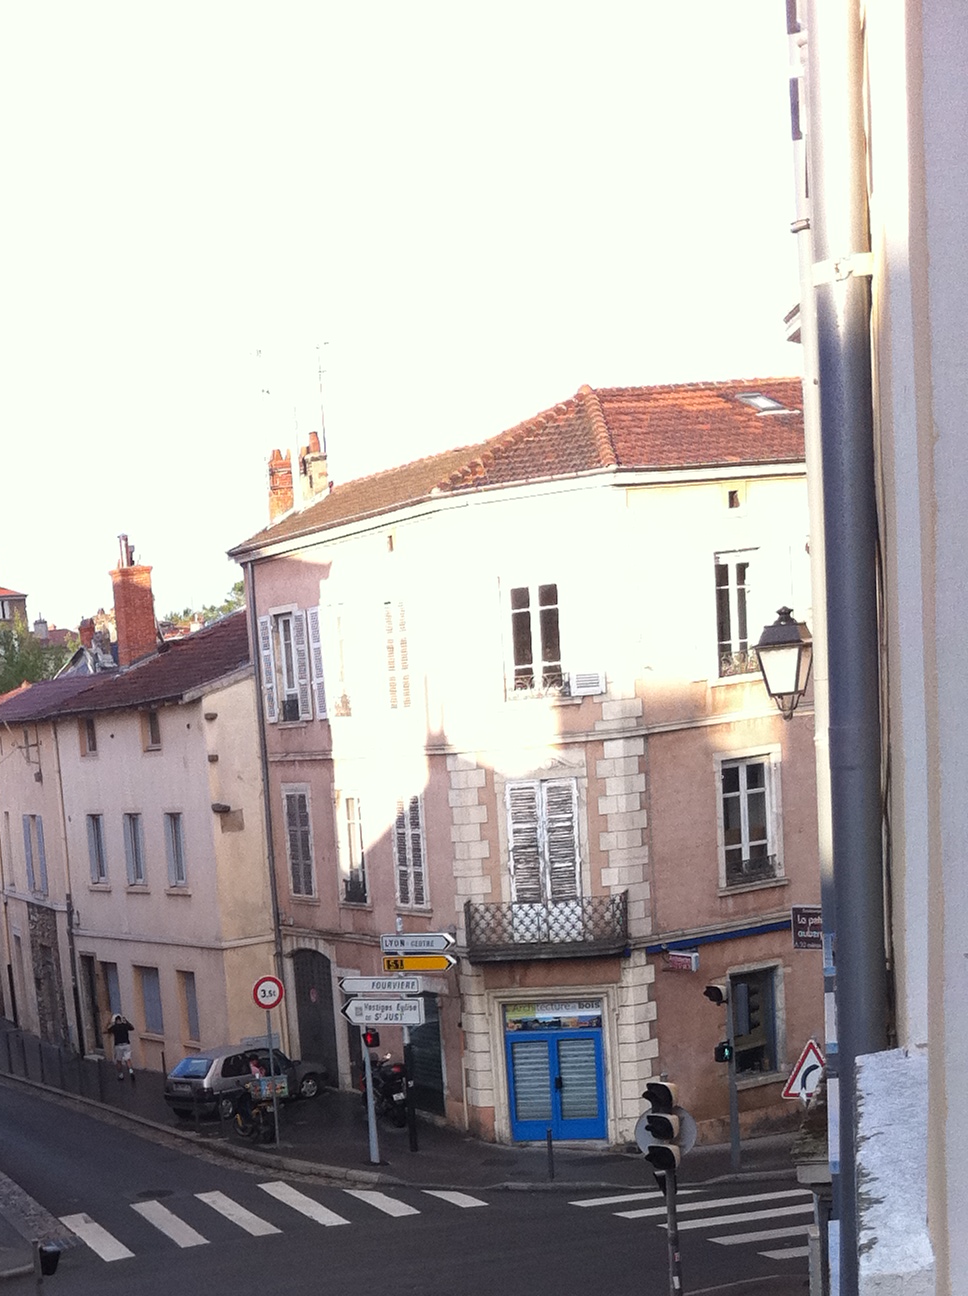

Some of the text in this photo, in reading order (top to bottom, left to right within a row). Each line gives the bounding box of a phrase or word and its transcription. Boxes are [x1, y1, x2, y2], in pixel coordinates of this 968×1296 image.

[384, 939, 405, 948] LYON
[578, 1000, 600, 1010] bois
[384, 1012, 404, 1021] JUST
